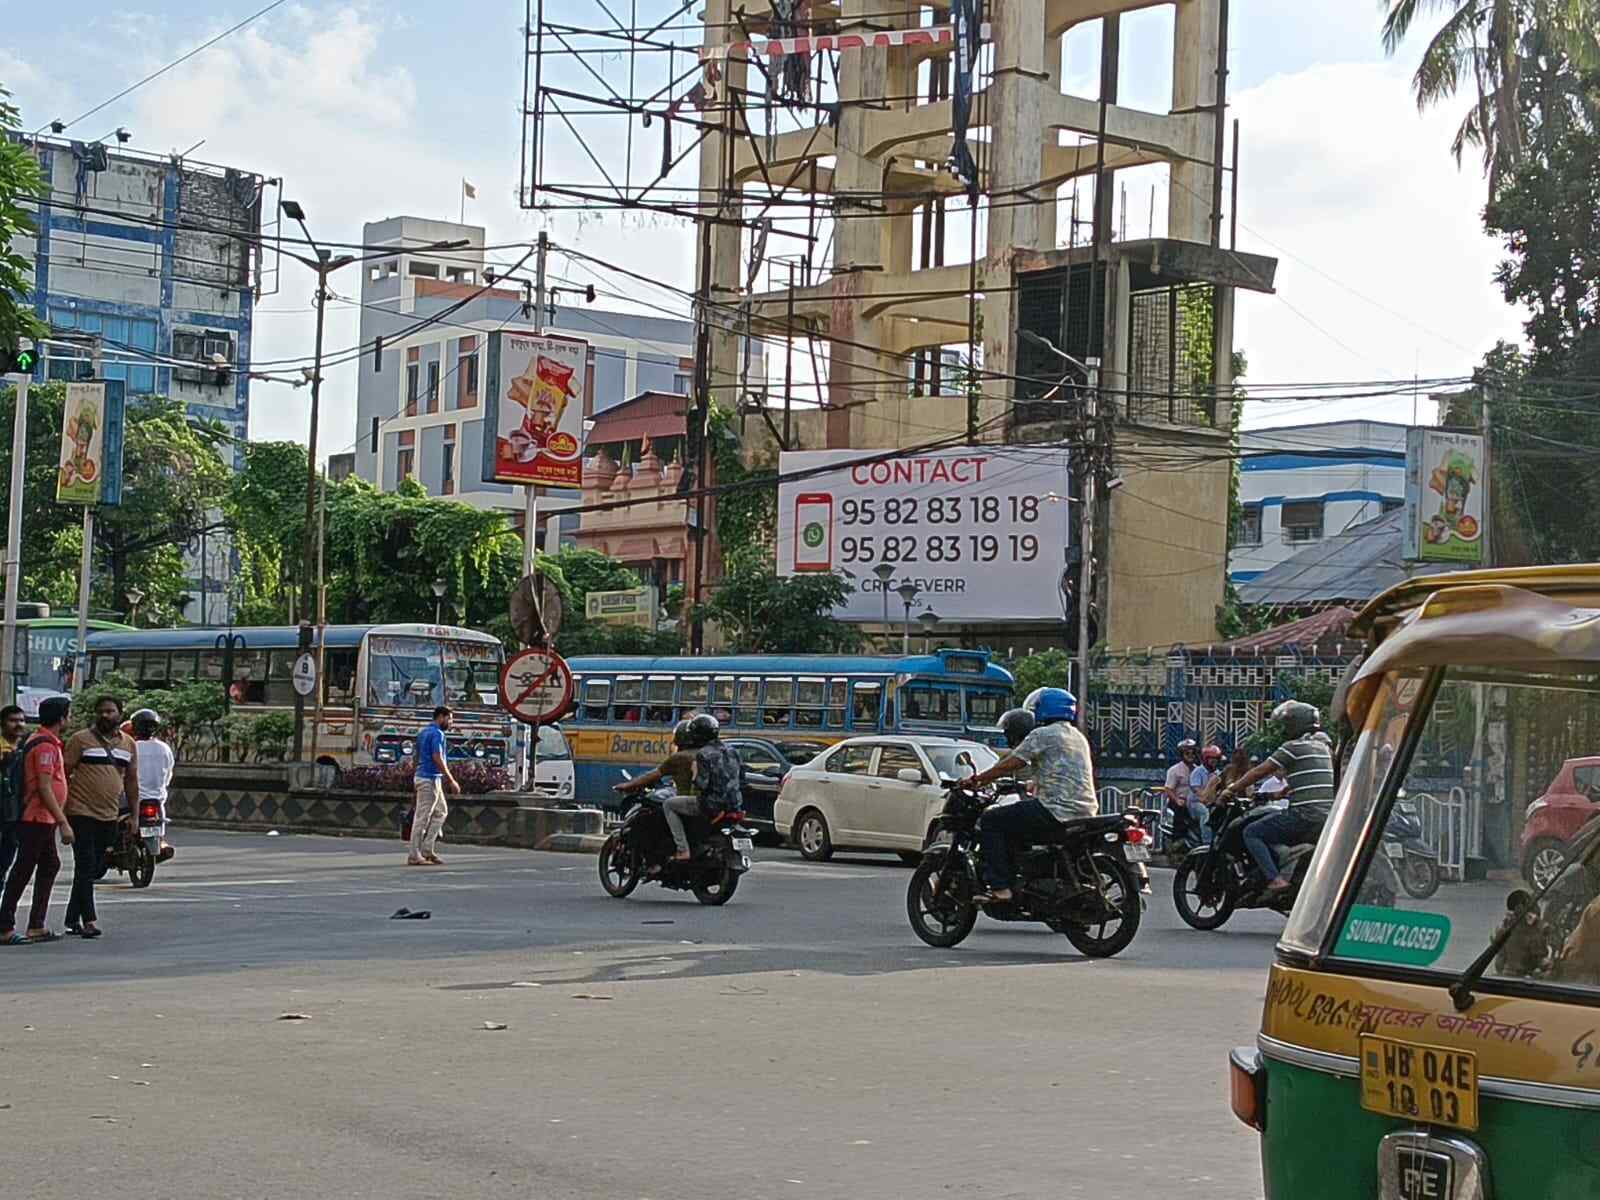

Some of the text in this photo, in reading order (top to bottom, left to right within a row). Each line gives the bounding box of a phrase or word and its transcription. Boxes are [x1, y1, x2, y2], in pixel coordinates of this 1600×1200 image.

[852, 457, 987, 485] CONTACT
[841, 495, 1040, 525] 95 82 83 18 18
[840, 535, 1039, 563] 95 82 83 19 19
[861, 578, 966, 593] CRCEVERR
[611, 734, 673, 754] Barrack
[1346, 919, 1442, 951] SUNDAY CLOSED
[1384, 1043, 1471, 1091] WB 04E
[1430, 1087, 1459, 1123] 03
